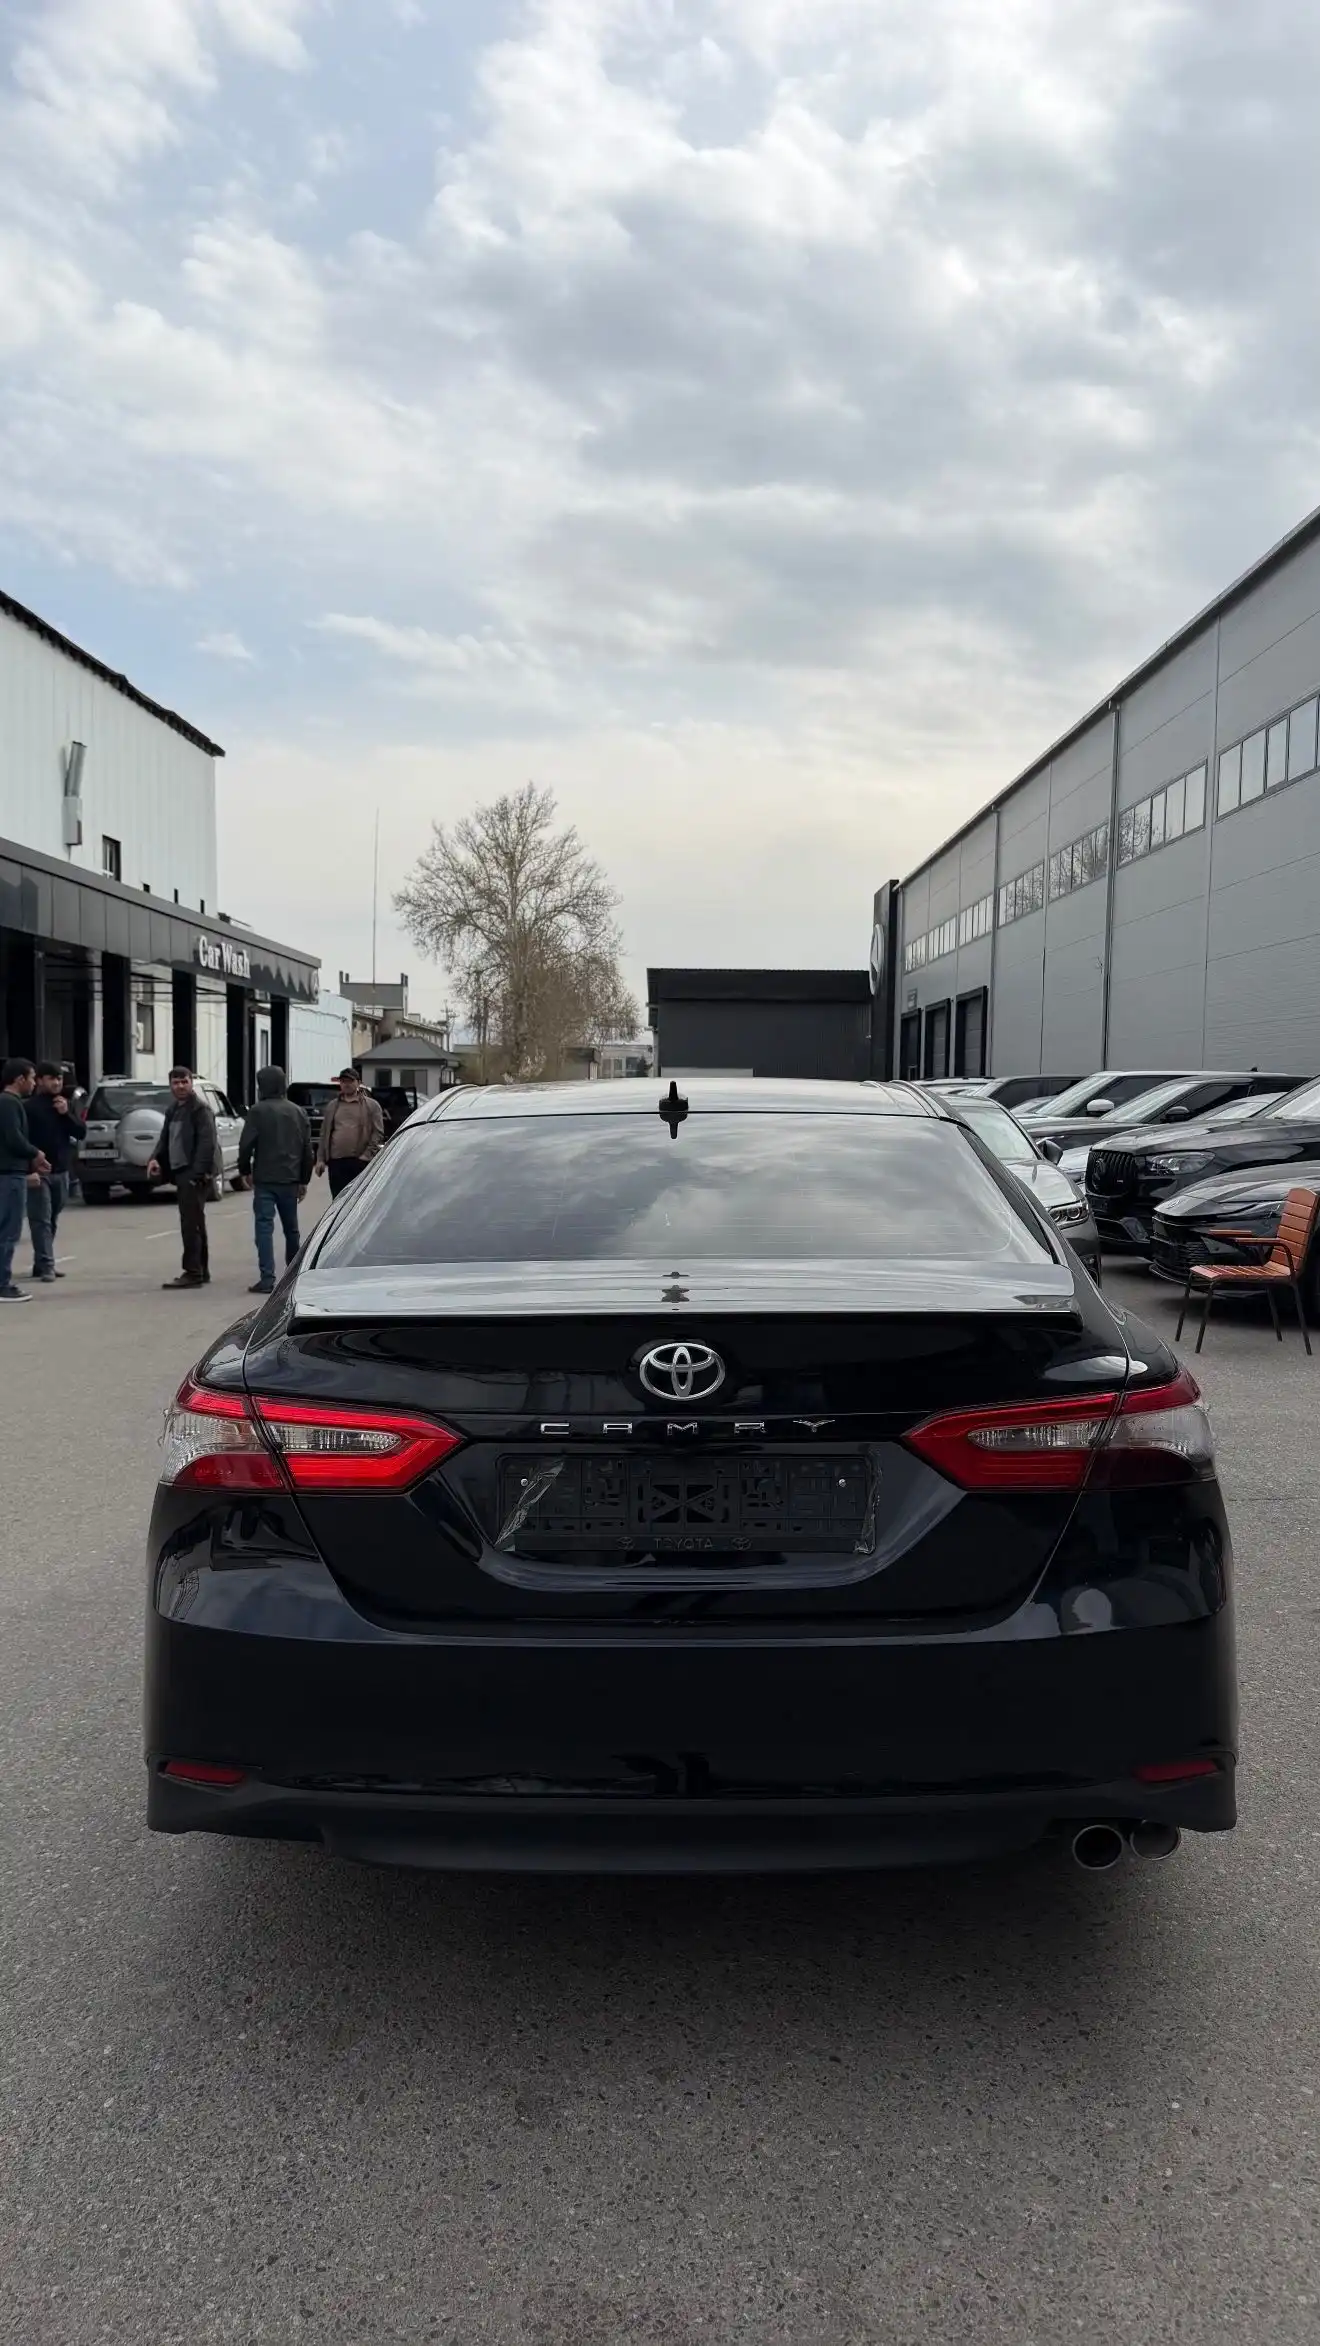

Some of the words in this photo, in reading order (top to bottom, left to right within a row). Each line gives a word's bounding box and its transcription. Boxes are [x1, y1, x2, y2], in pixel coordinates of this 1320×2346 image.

[199, 935, 220, 970] Car
[221, 942, 251, 979] Wash
[540, 1419, 836, 1435] CAMRY
